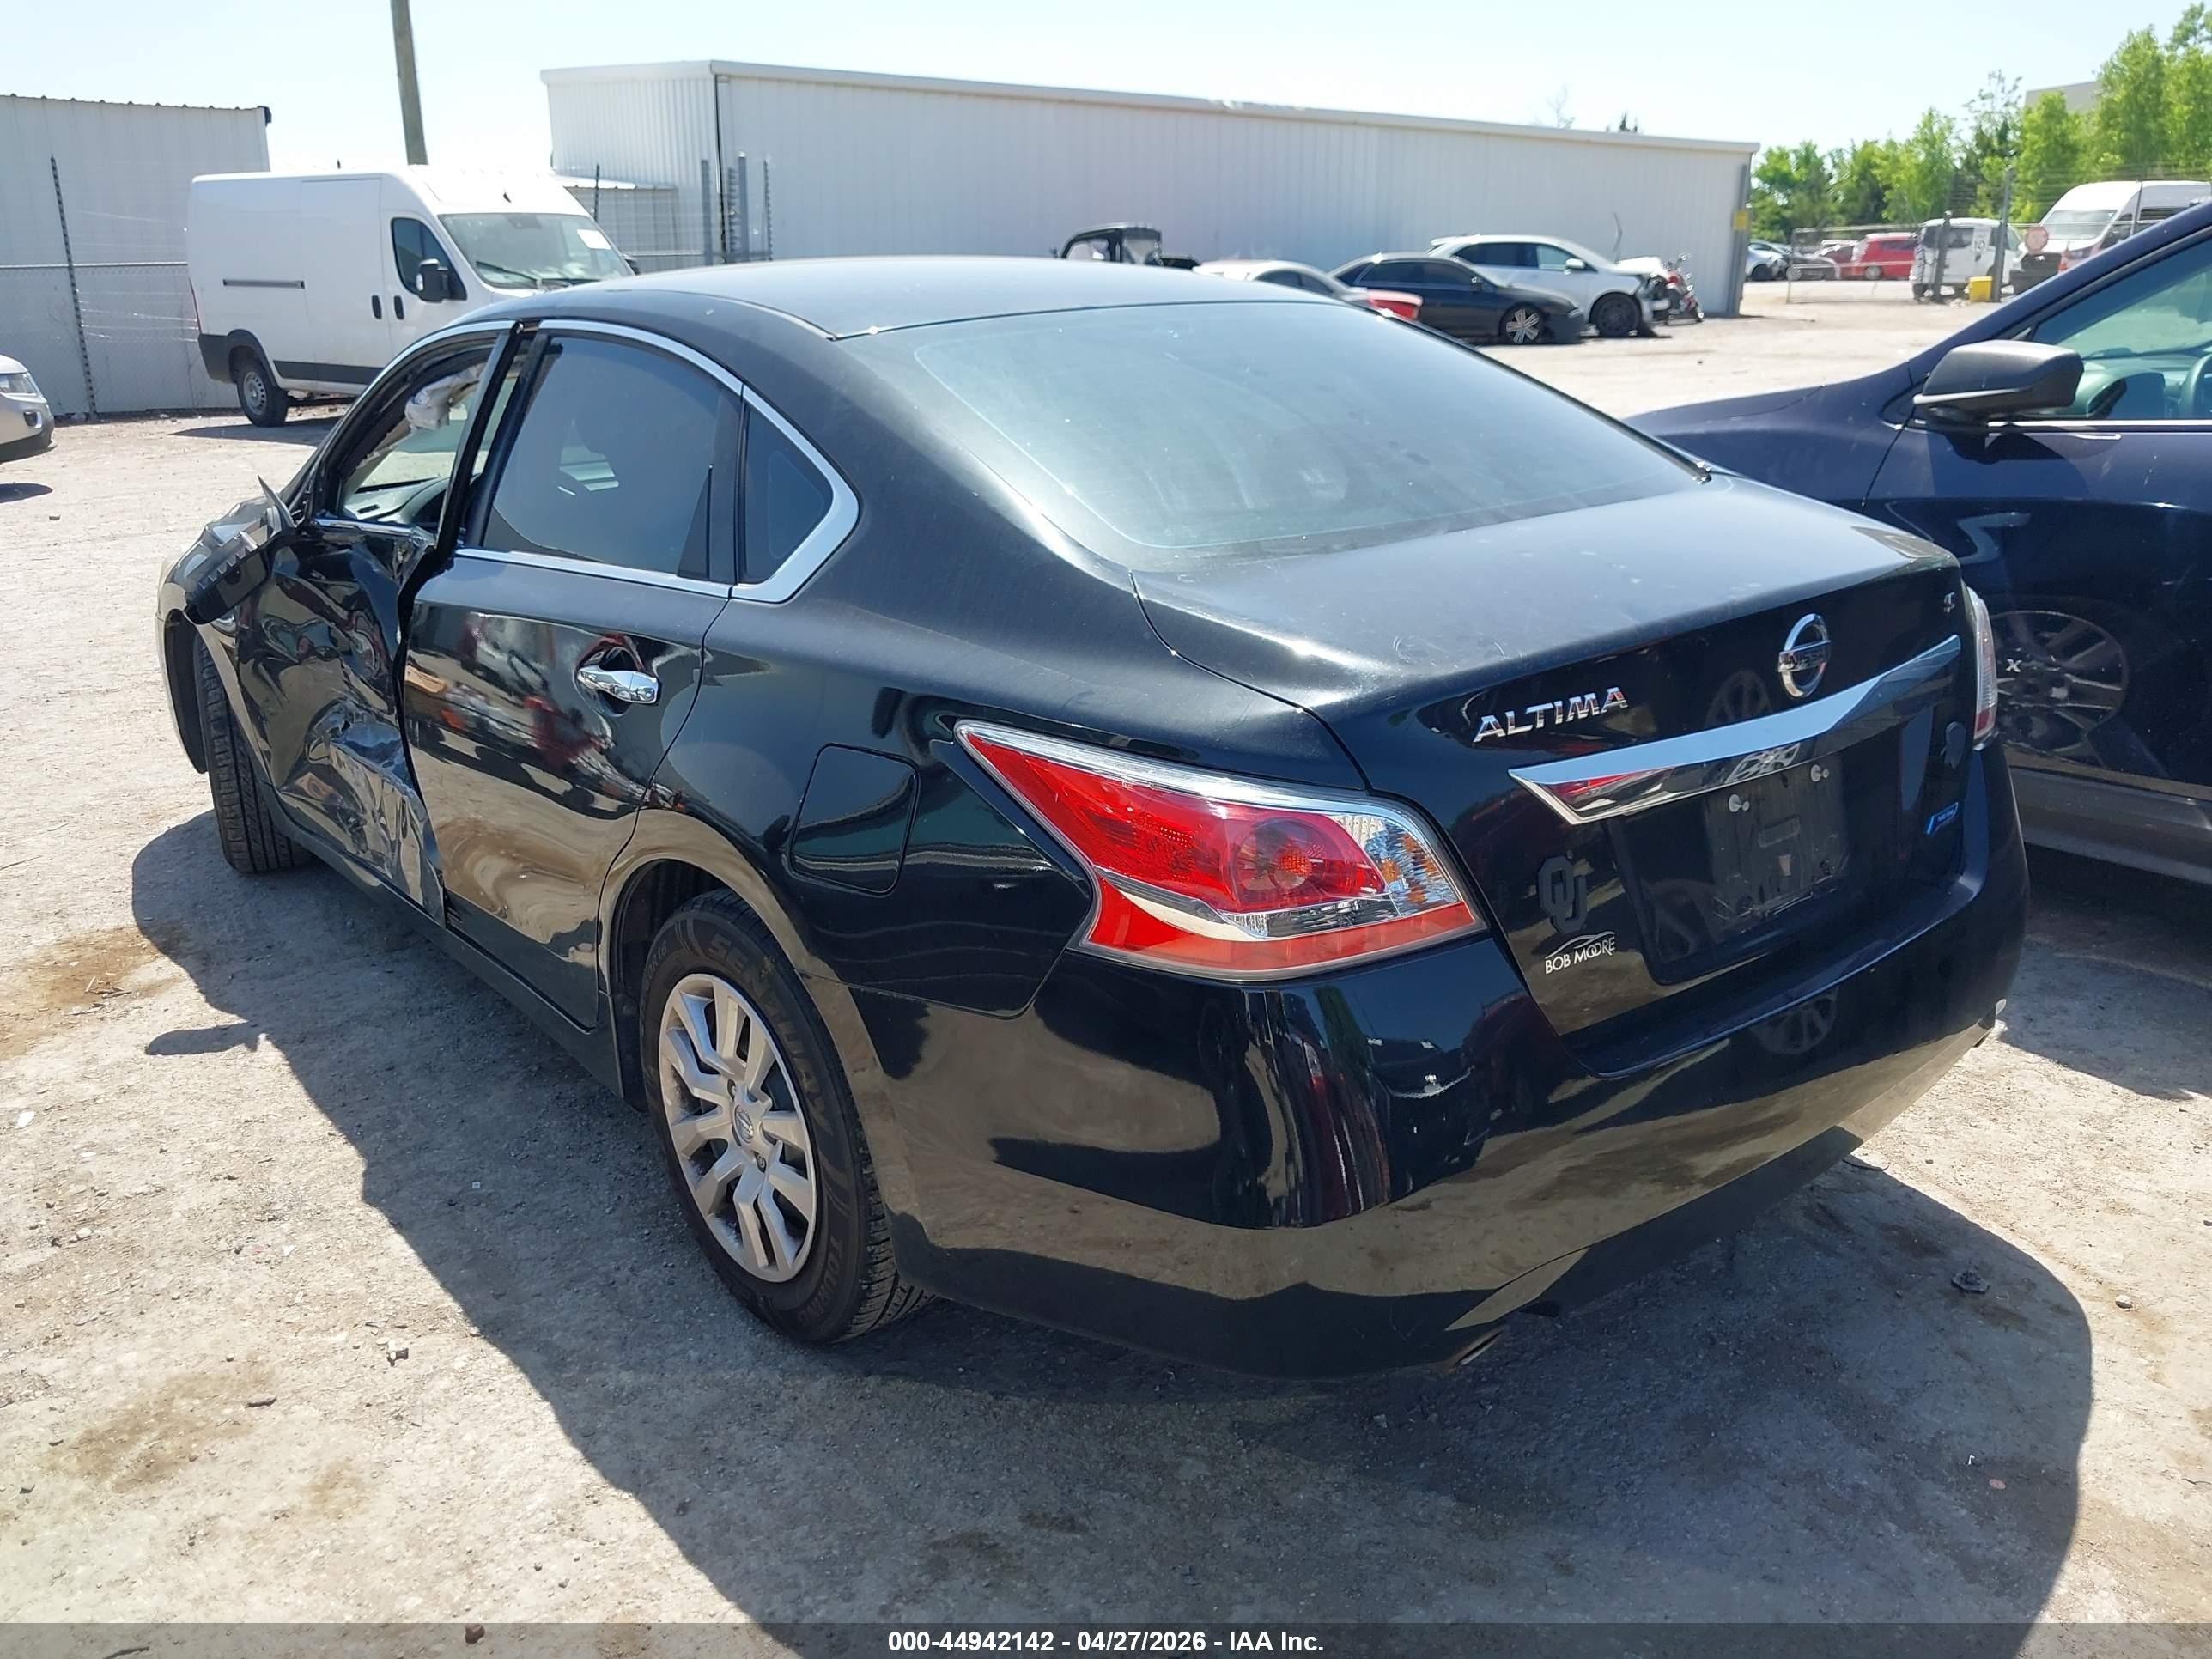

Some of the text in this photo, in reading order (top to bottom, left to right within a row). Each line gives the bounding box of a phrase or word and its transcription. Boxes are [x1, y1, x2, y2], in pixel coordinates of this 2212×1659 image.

[1474, 687, 1628, 742] ALTIMA
[1546, 936, 1616, 975] BOB MOORE
